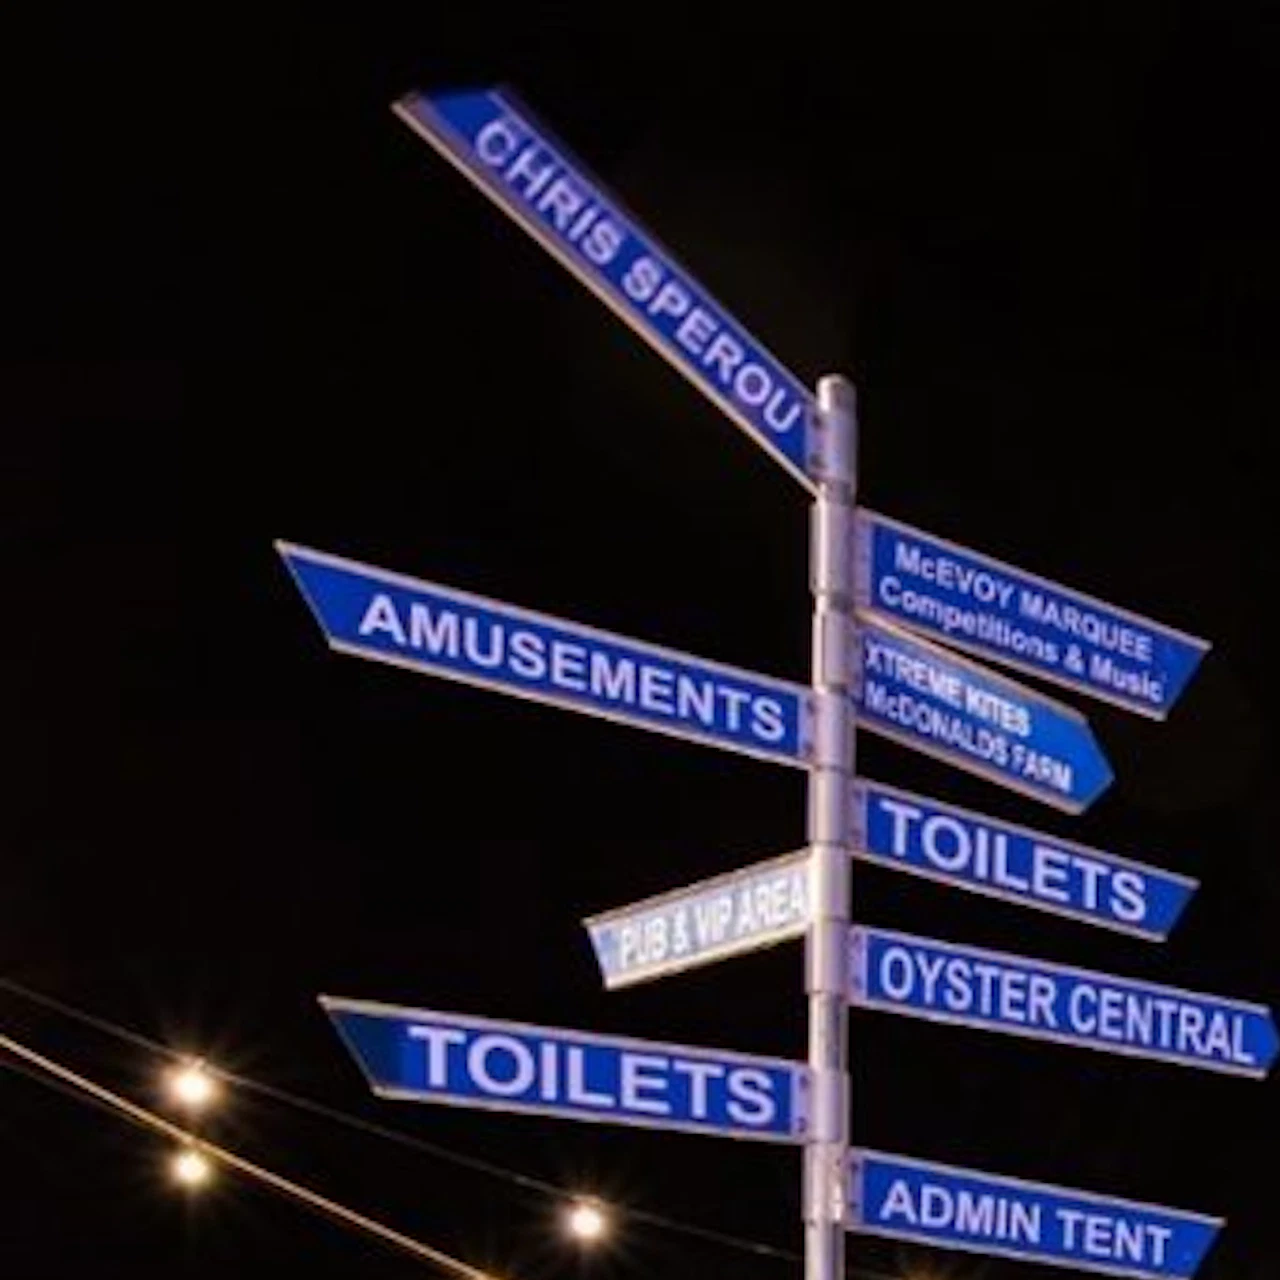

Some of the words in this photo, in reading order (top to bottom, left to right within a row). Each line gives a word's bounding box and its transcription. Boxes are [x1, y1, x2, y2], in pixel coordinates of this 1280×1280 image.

[475, 120, 621, 265] CHRIS
[621, 256, 800, 433] SPEROU
[878, 575, 1059, 664] Competitions
[1063, 643, 1085, 675] &
[1090, 652, 1164, 704] Music
[894, 541, 1014, 610] McEVOY
[1019, 590, 1153, 663] MARQUEE
[358, 593, 786, 741] AMUSEMENTS
[1010, 743, 1073, 793] FARM
[879, 799, 1147, 922] TOILETS
[620, 915, 668, 969] PUB
[694, 896, 733, 946] VIP
[735, 873, 808, 934] AREA
[879, 947, 1057, 1029] OYSTER
[1069, 983, 1255, 1065] CENTRAL
[407, 1025, 776, 1125] TOILETS
[879, 1179, 1042, 1244] ADMIN
[1056, 1208, 1172, 1266] TENT
